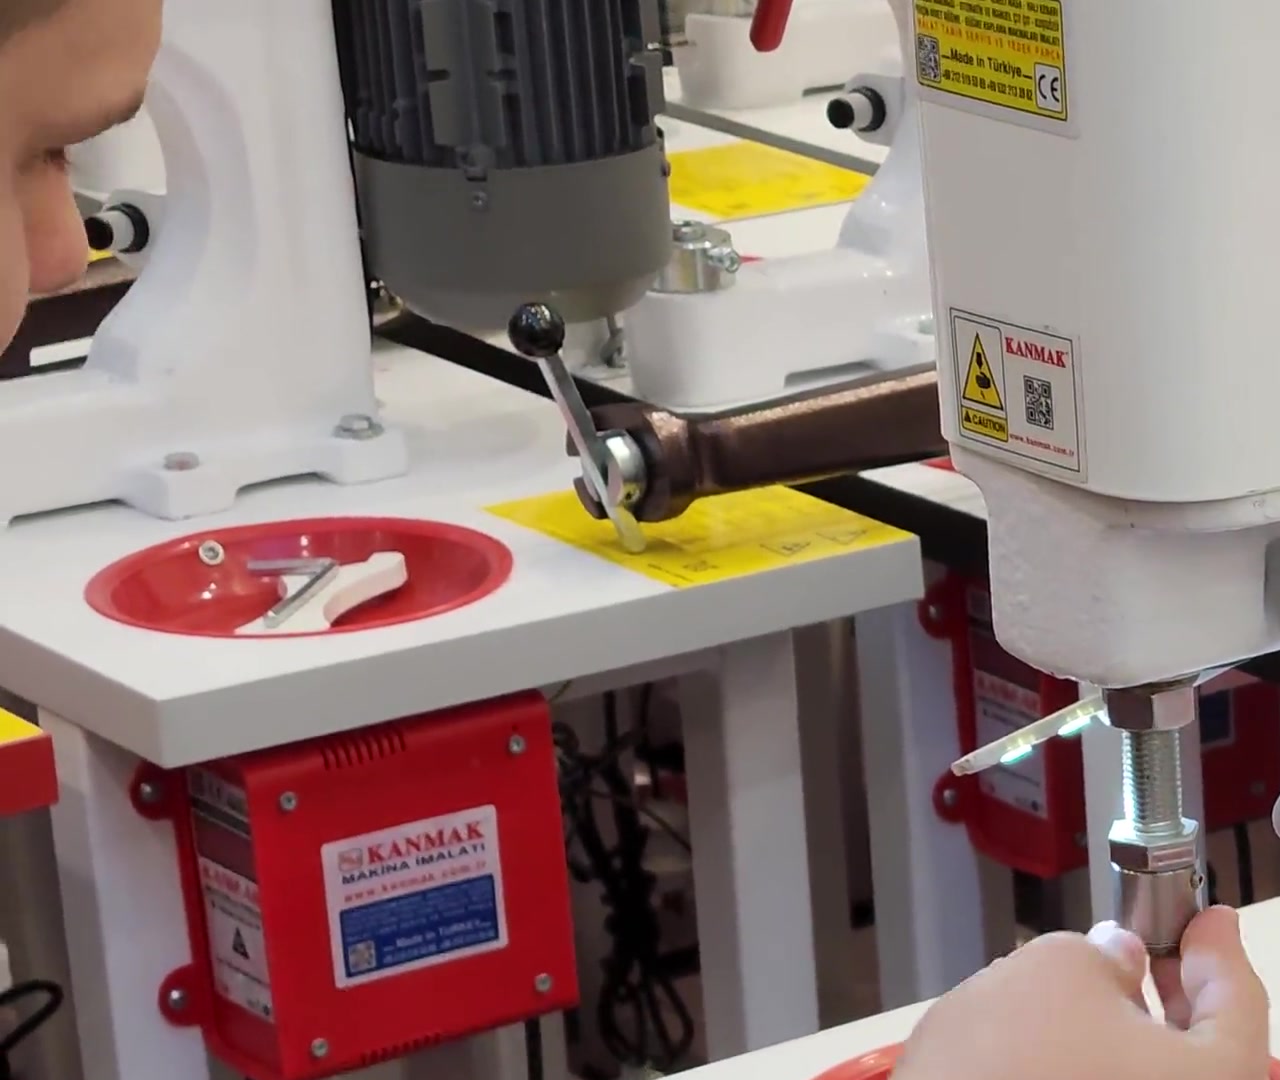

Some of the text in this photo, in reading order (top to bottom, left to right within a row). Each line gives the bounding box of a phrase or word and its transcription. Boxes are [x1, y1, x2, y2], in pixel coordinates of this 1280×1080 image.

[976, 54, 985, 68] in
[987, 57, 1022, 79] Türkiye
[1037, 73, 1060, 103] CE
[1004, 336, 1067, 368] KANMAK
[972, 414, 1006, 434] CAUTION
[367, 820, 485, 865] KANMAK
